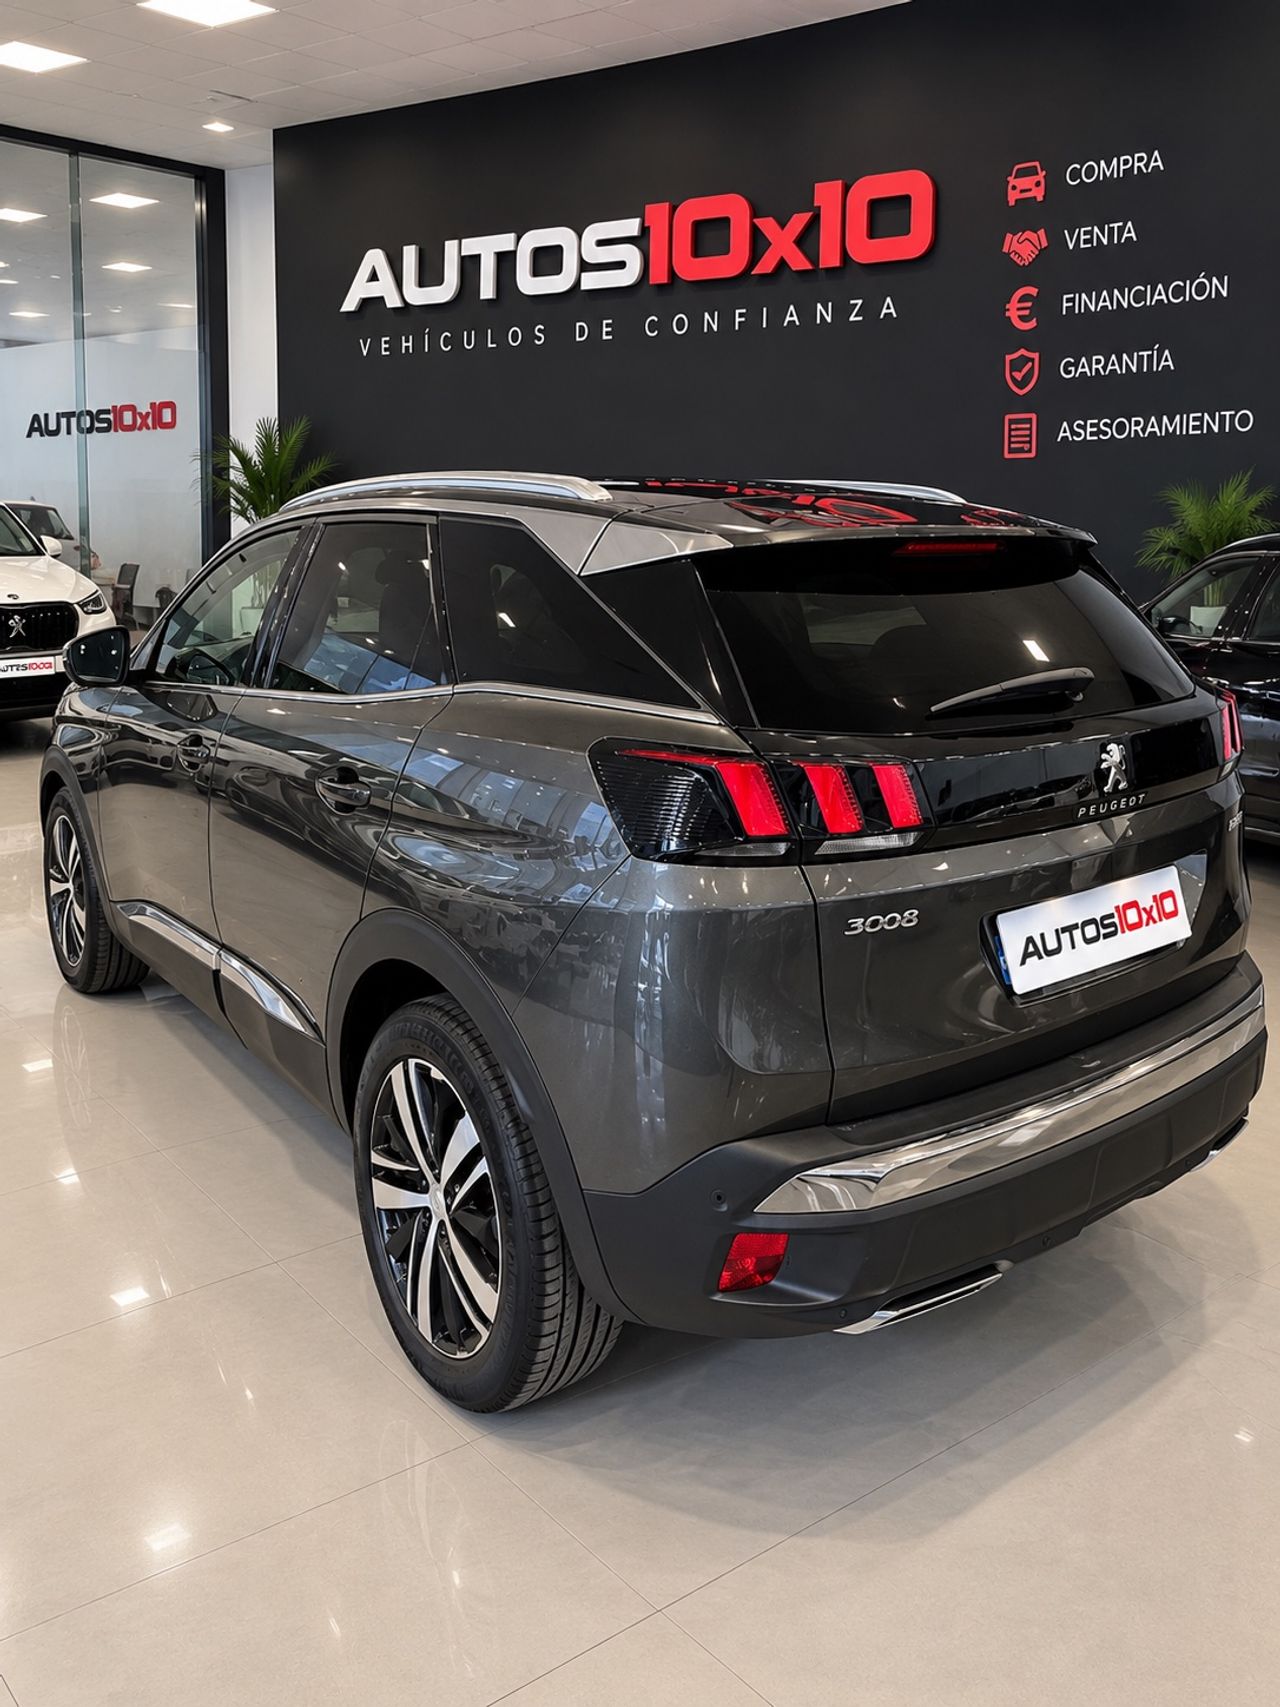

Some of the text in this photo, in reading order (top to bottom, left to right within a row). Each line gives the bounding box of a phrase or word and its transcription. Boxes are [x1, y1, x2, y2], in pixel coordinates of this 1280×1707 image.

[1065, 149, 1165, 186] COMPRA
[340, 169, 936, 313] AUTOS10x10
[1063, 221, 1138, 250] VENTA
[1061, 272, 1229, 316] FINANCIACIÓN
[359, 296, 898, 357] VEHÍCULOS DE CONFIANZA
[1059, 343, 1175, 379] GARANTÍA
[26, 400, 177, 438] AUTOS10x10
[1056, 409, 1255, 442] ASESORAMIENTO
[1077, 793, 1146, 819] PEUGEOT
[844, 909, 919, 935] 3008
[1019, 889, 1181, 967] AUTOS10x10
